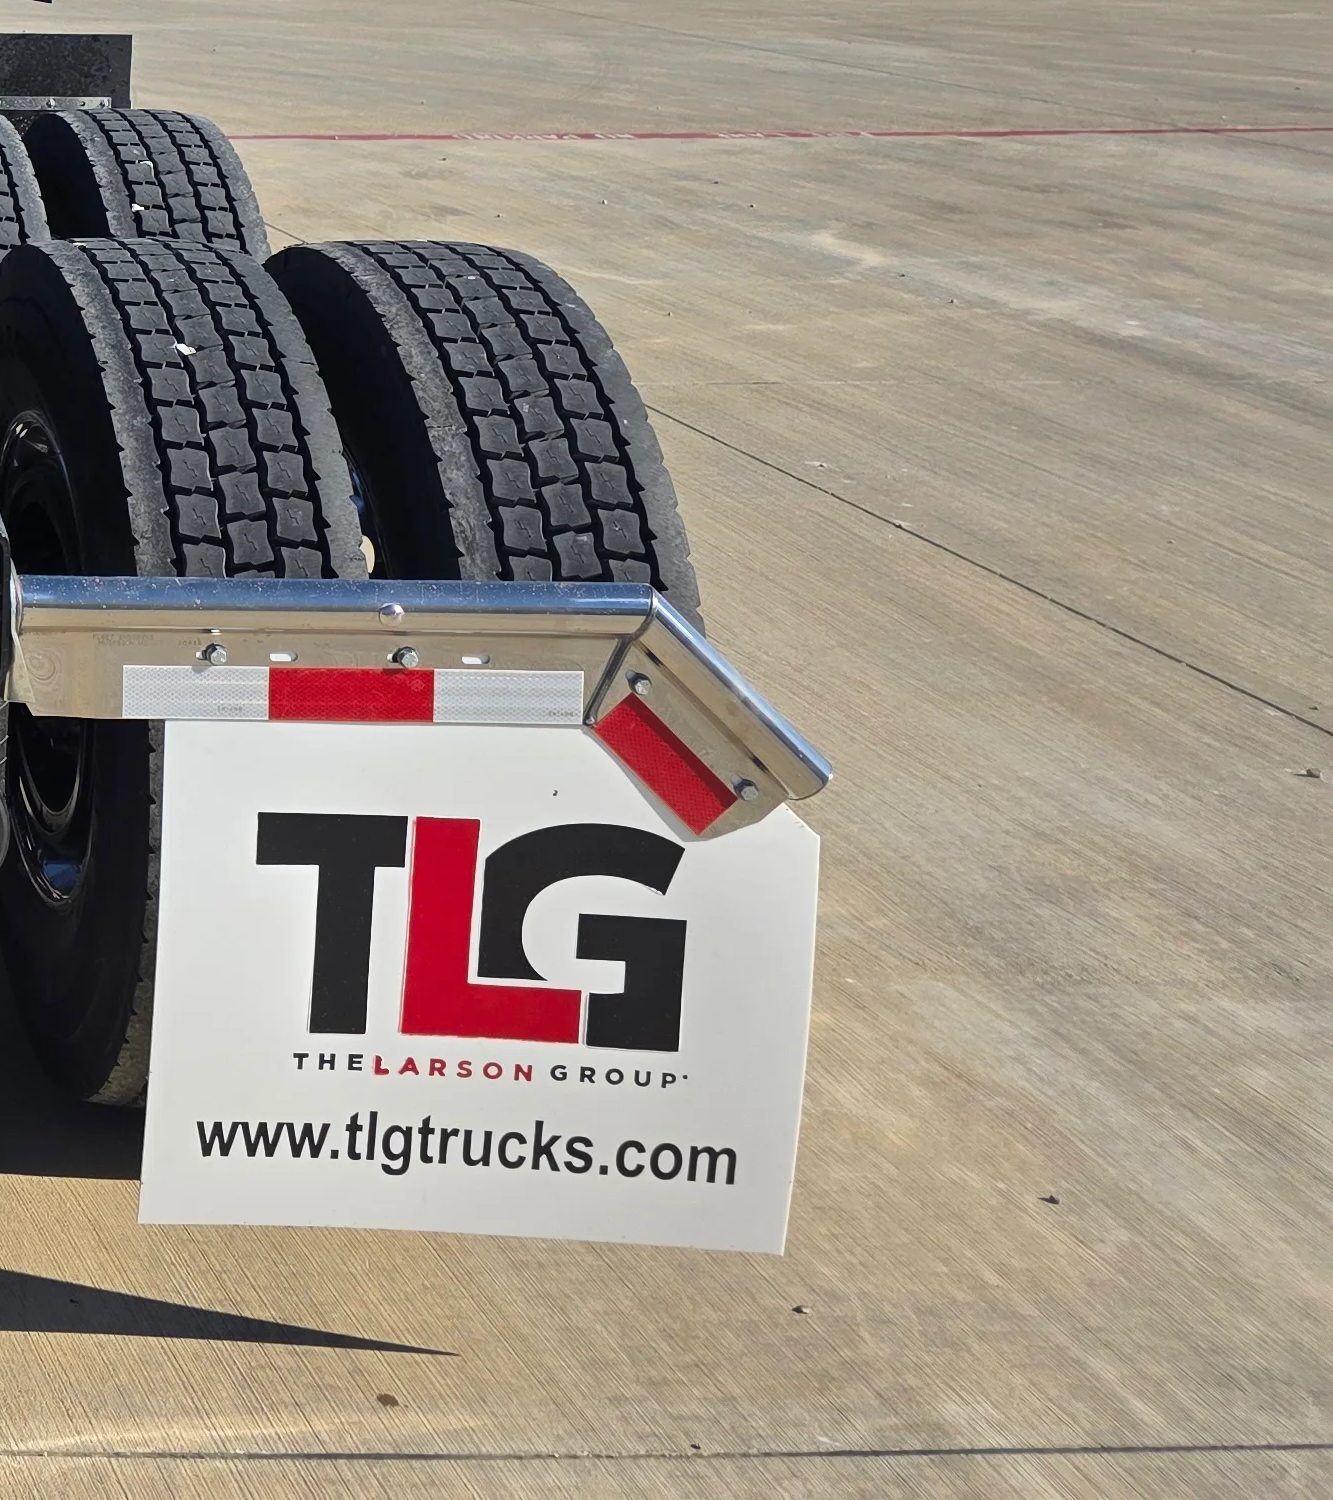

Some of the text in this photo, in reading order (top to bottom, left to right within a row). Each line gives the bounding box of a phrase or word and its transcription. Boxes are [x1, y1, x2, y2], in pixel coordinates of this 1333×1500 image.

[255, 811, 688, 1053] TLG
[292, 1052, 677, 1089] THE LARSON GROUP
[196, 1110, 737, 1186] www.tlgtrucks.com
